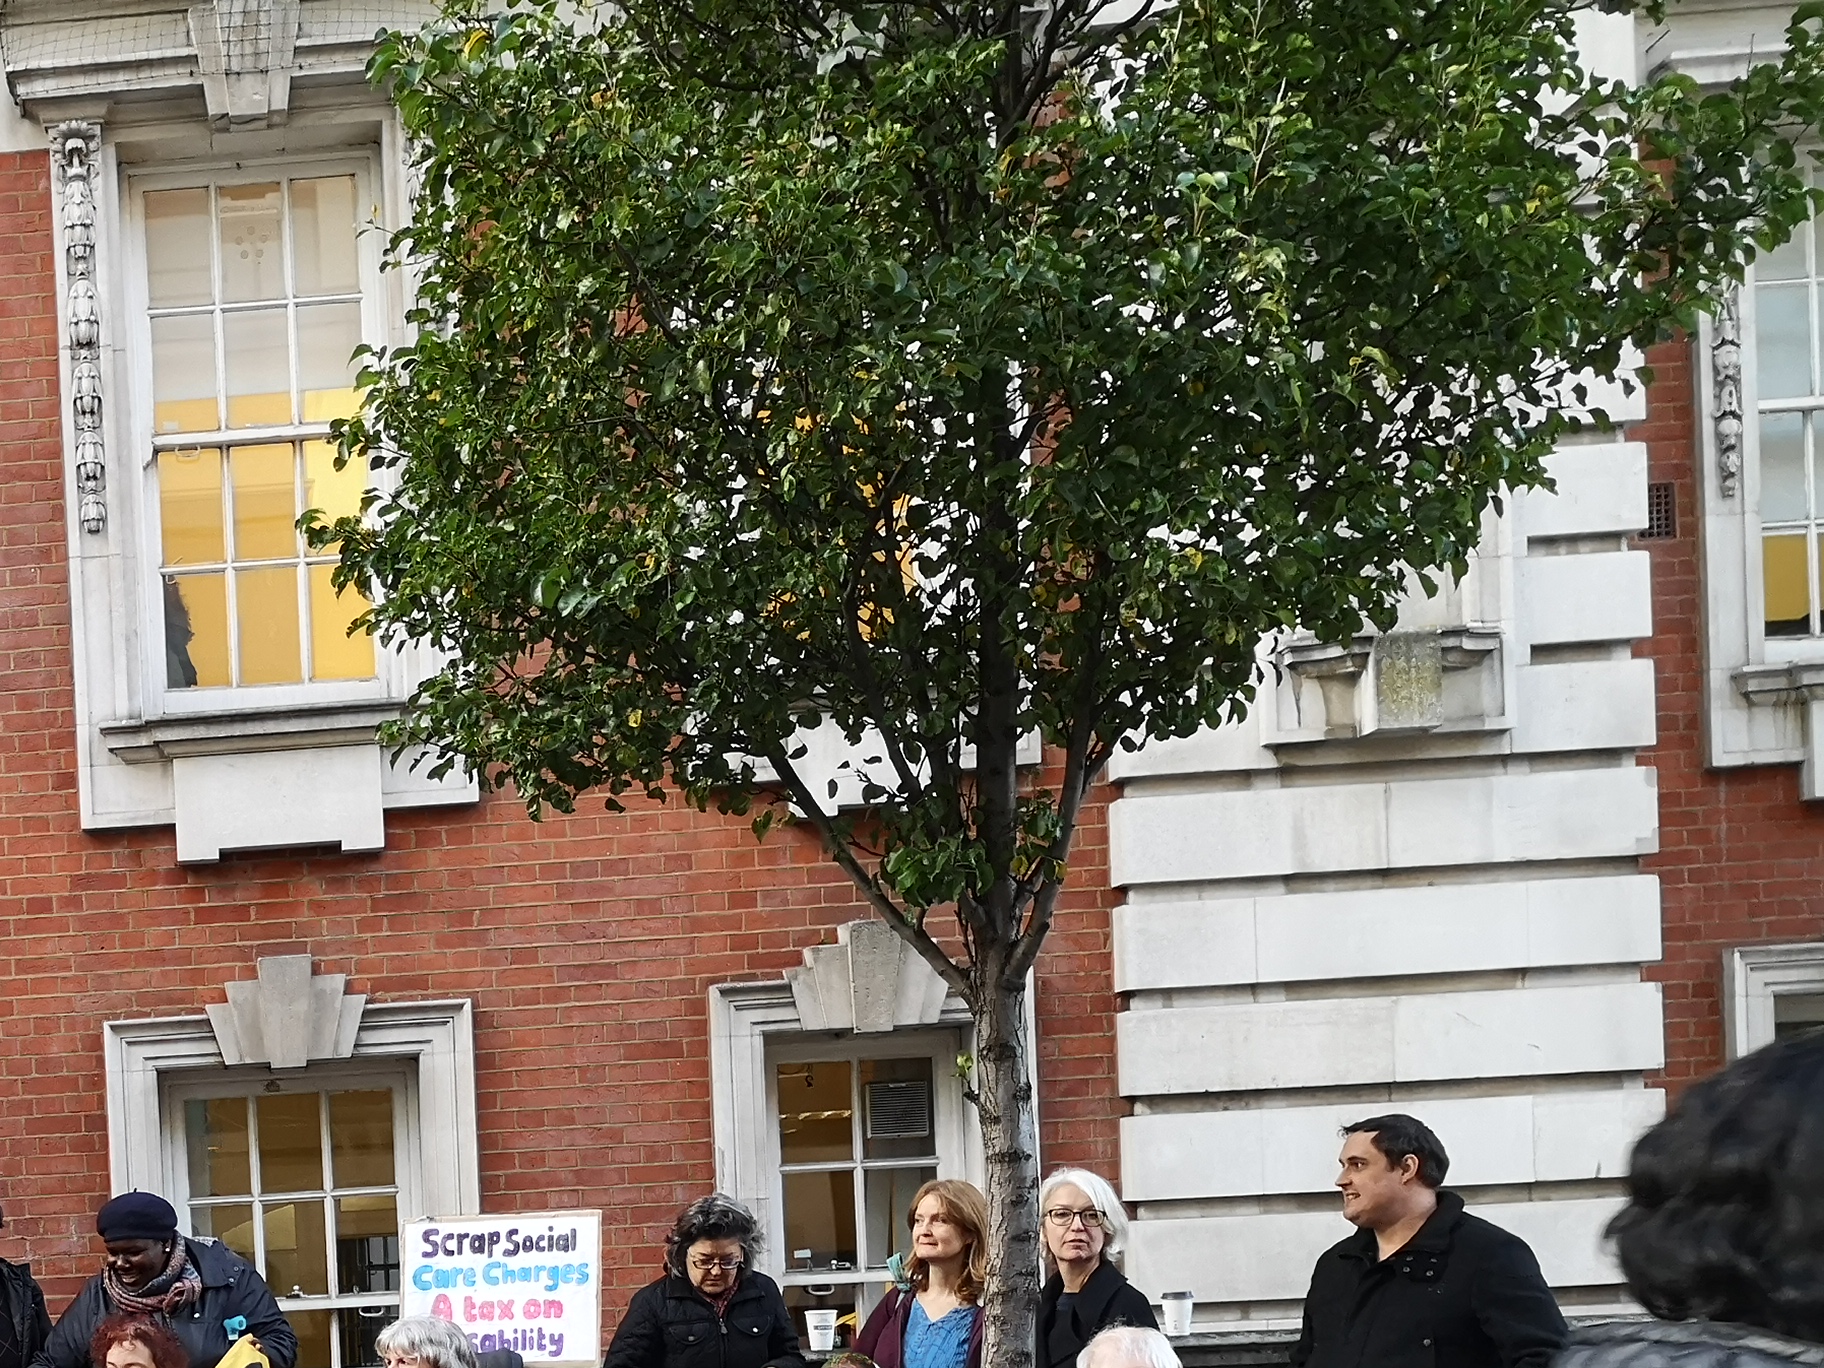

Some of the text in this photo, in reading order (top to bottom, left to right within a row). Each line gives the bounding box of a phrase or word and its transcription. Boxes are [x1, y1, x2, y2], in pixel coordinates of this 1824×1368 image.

[421, 1225, 577, 1259] Scrap Social
[412, 1261, 589, 1292] Care Charges
[430, 1293, 564, 1323] A tax on
[467, 1326, 564, 1358] sability
